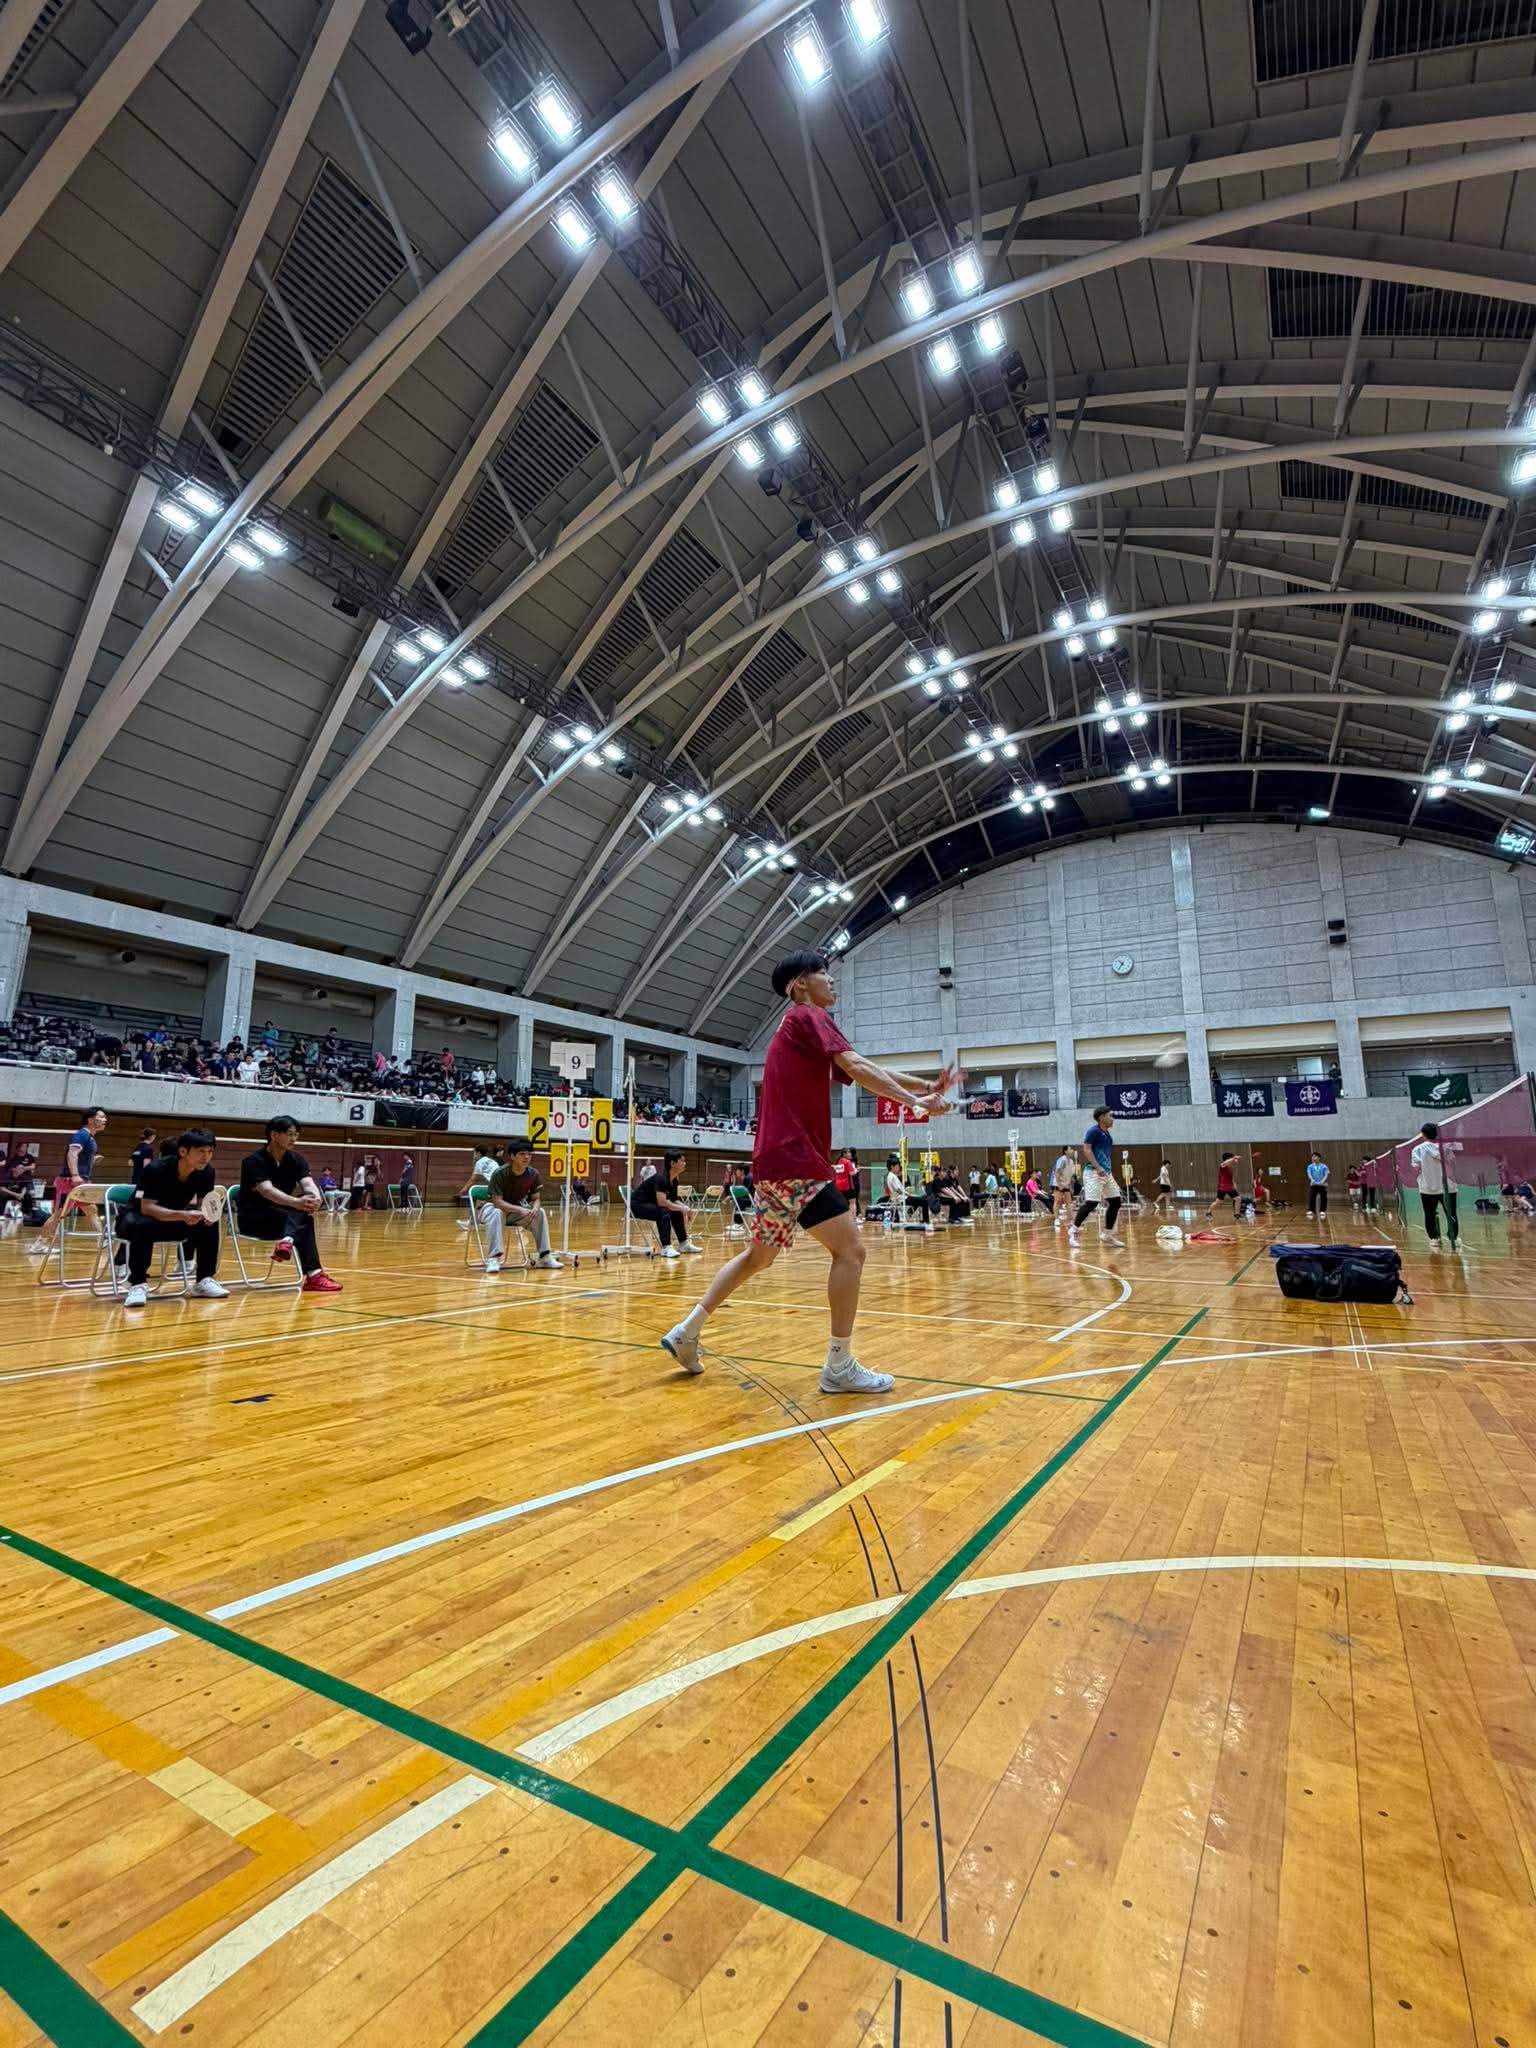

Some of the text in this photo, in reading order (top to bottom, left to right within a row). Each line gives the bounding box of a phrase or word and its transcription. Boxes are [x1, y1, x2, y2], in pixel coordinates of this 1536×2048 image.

[571, 1055, 581, 1070] 9
[1223, 1090, 1266, 1108] 挑戦
[349, 1104, 364, 1120] B
[531, 1112, 611, 1145] 2 0 0 0
[693, 1133, 700, 1144] C
[553, 1158, 587, 1174] 0 0
